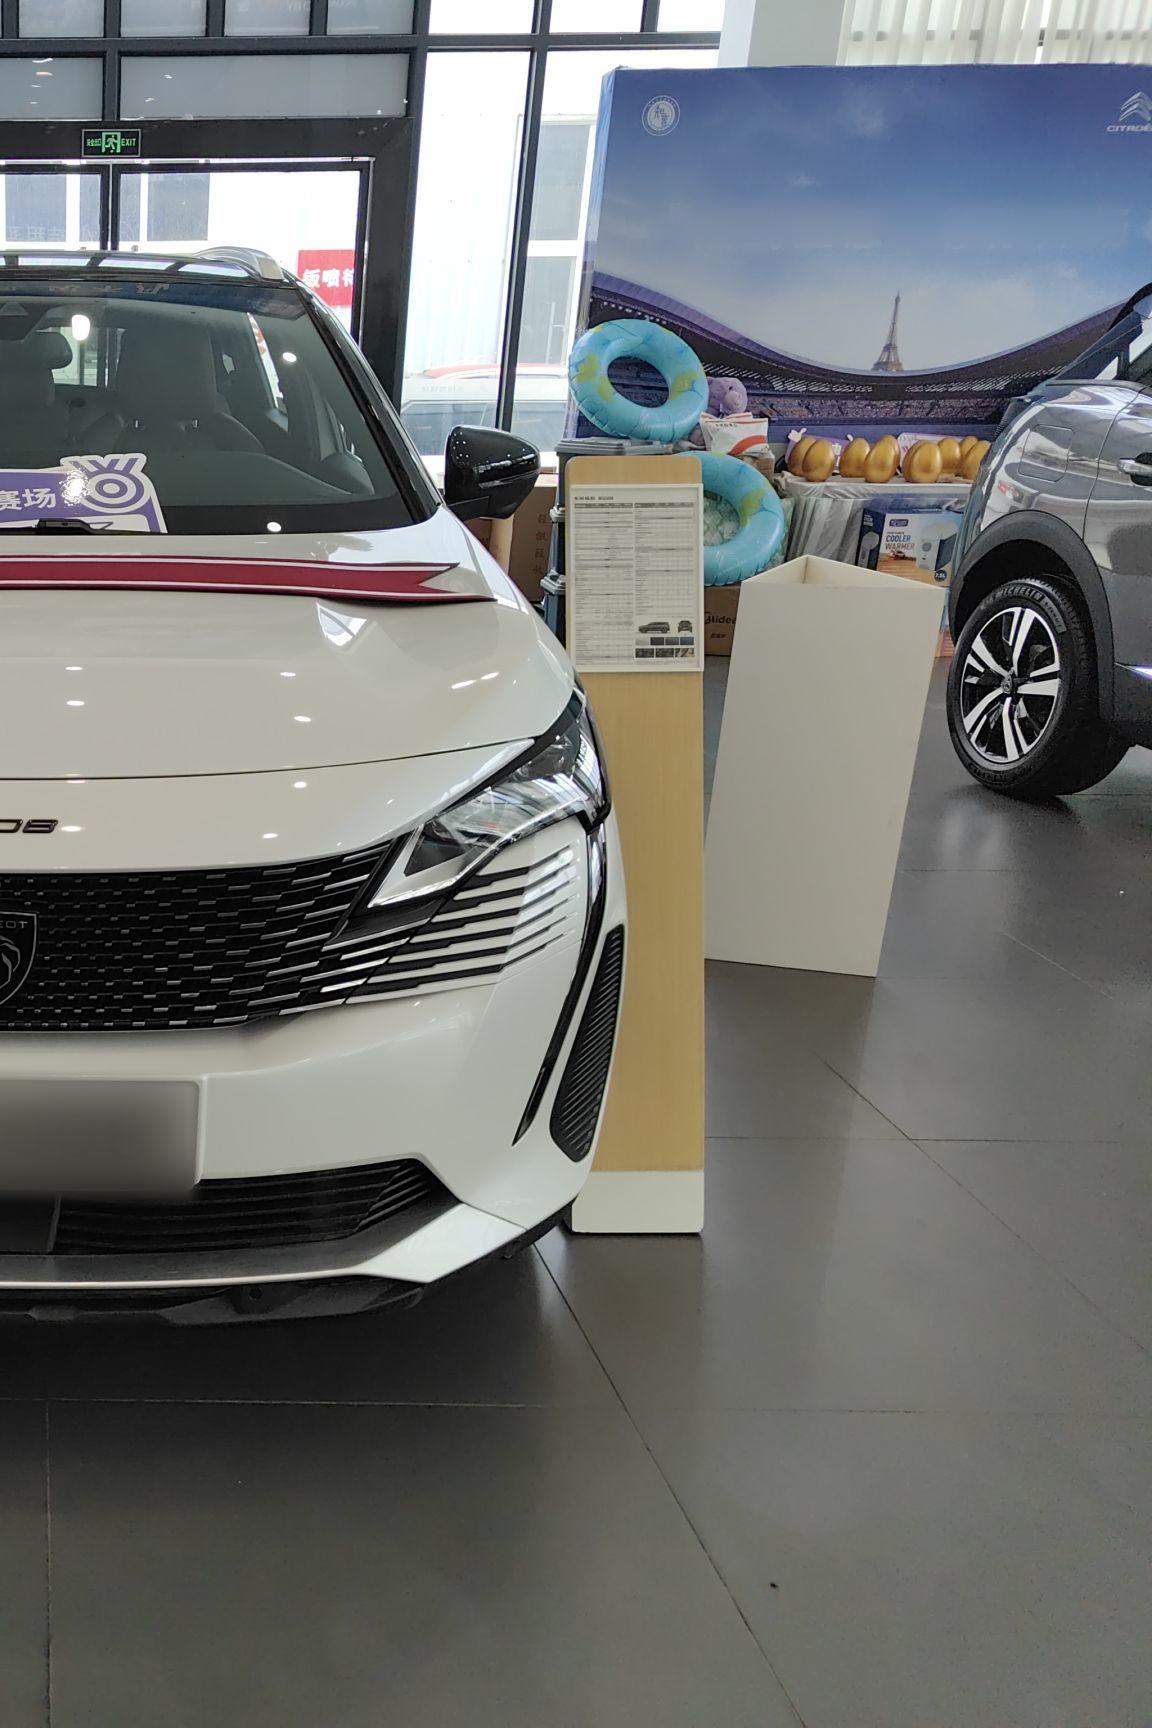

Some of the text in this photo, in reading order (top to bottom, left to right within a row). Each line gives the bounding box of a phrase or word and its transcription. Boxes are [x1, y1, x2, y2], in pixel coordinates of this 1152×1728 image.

[1106, 123, 1152, 132] CITROË
[121, 138, 136, 147] EXIT
[886, 534, 912, 543] COOLER
[885, 542, 916, 551] WARMER
